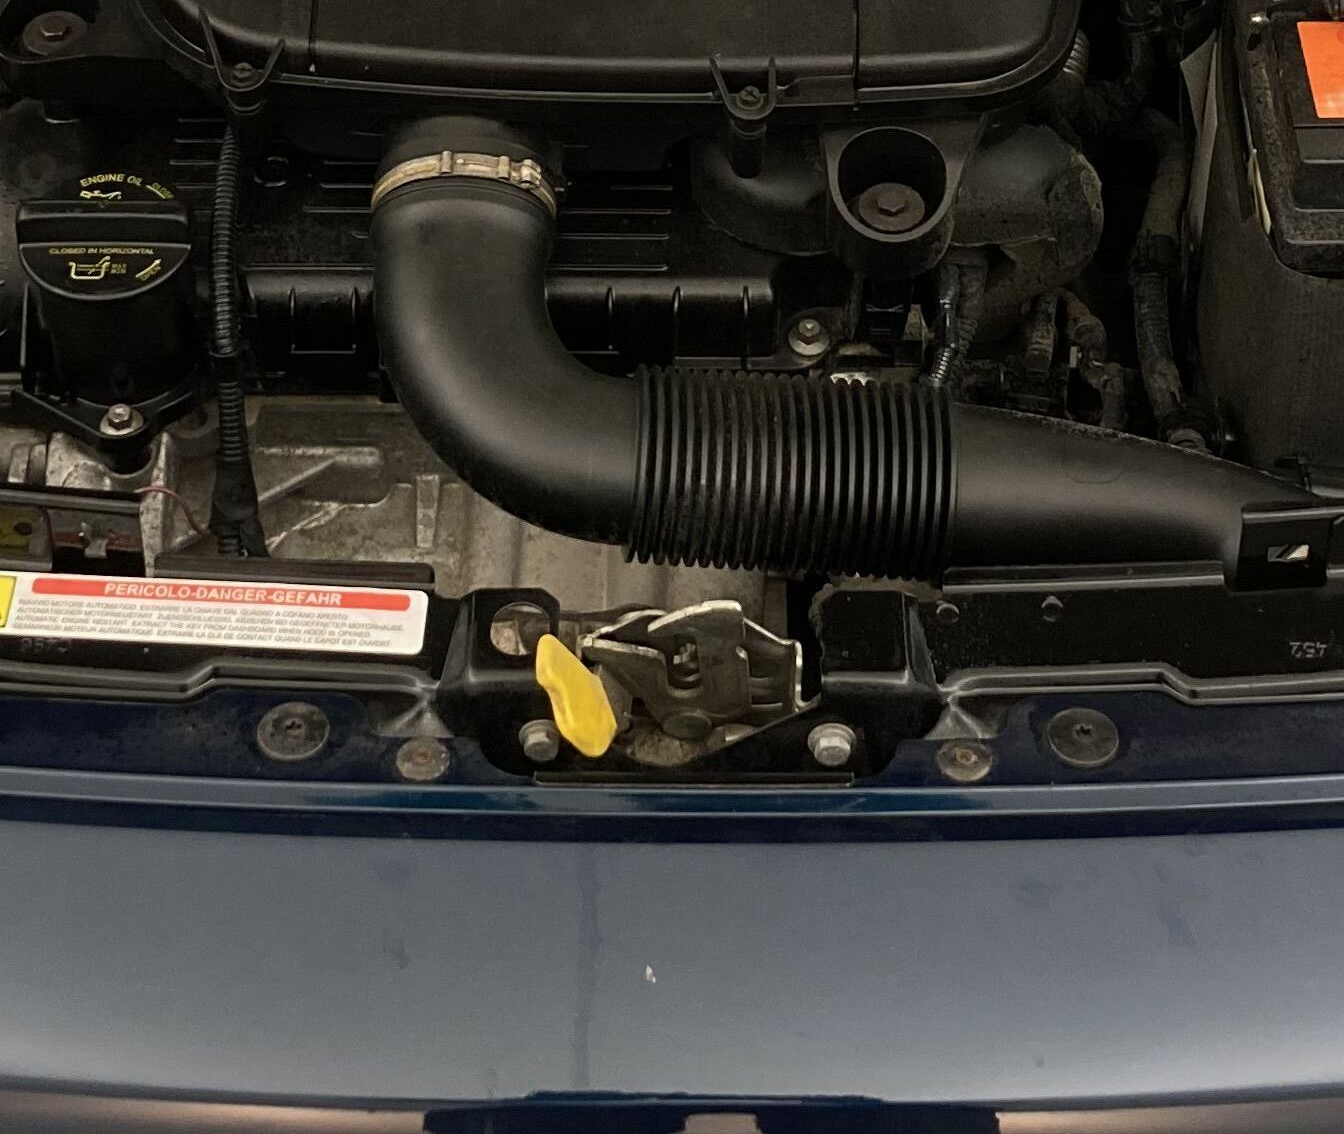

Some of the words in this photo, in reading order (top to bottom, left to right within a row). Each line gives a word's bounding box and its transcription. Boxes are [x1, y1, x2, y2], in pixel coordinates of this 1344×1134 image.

[80, 173, 126, 188] ENGINE
[126, 175, 144, 187] OIL
[49, 247, 86, 255] CLOSED
[87, 247, 98, 255] IN
[99, 247, 154, 255] HORIZONTAL
[104, 583, 342, 606] PERICOLO-DANGER-GEFAHR
[240, 609, 273, 617] QUADRO
[15, 615, 58, 623] AUTOMATIC
[132, 620, 167, 628] EXTRACT
[228, 625, 277, 633] DASHBOARD
[64, 625, 97, 633] MOTEUR
[236, 633, 273, 641] CONTACT
